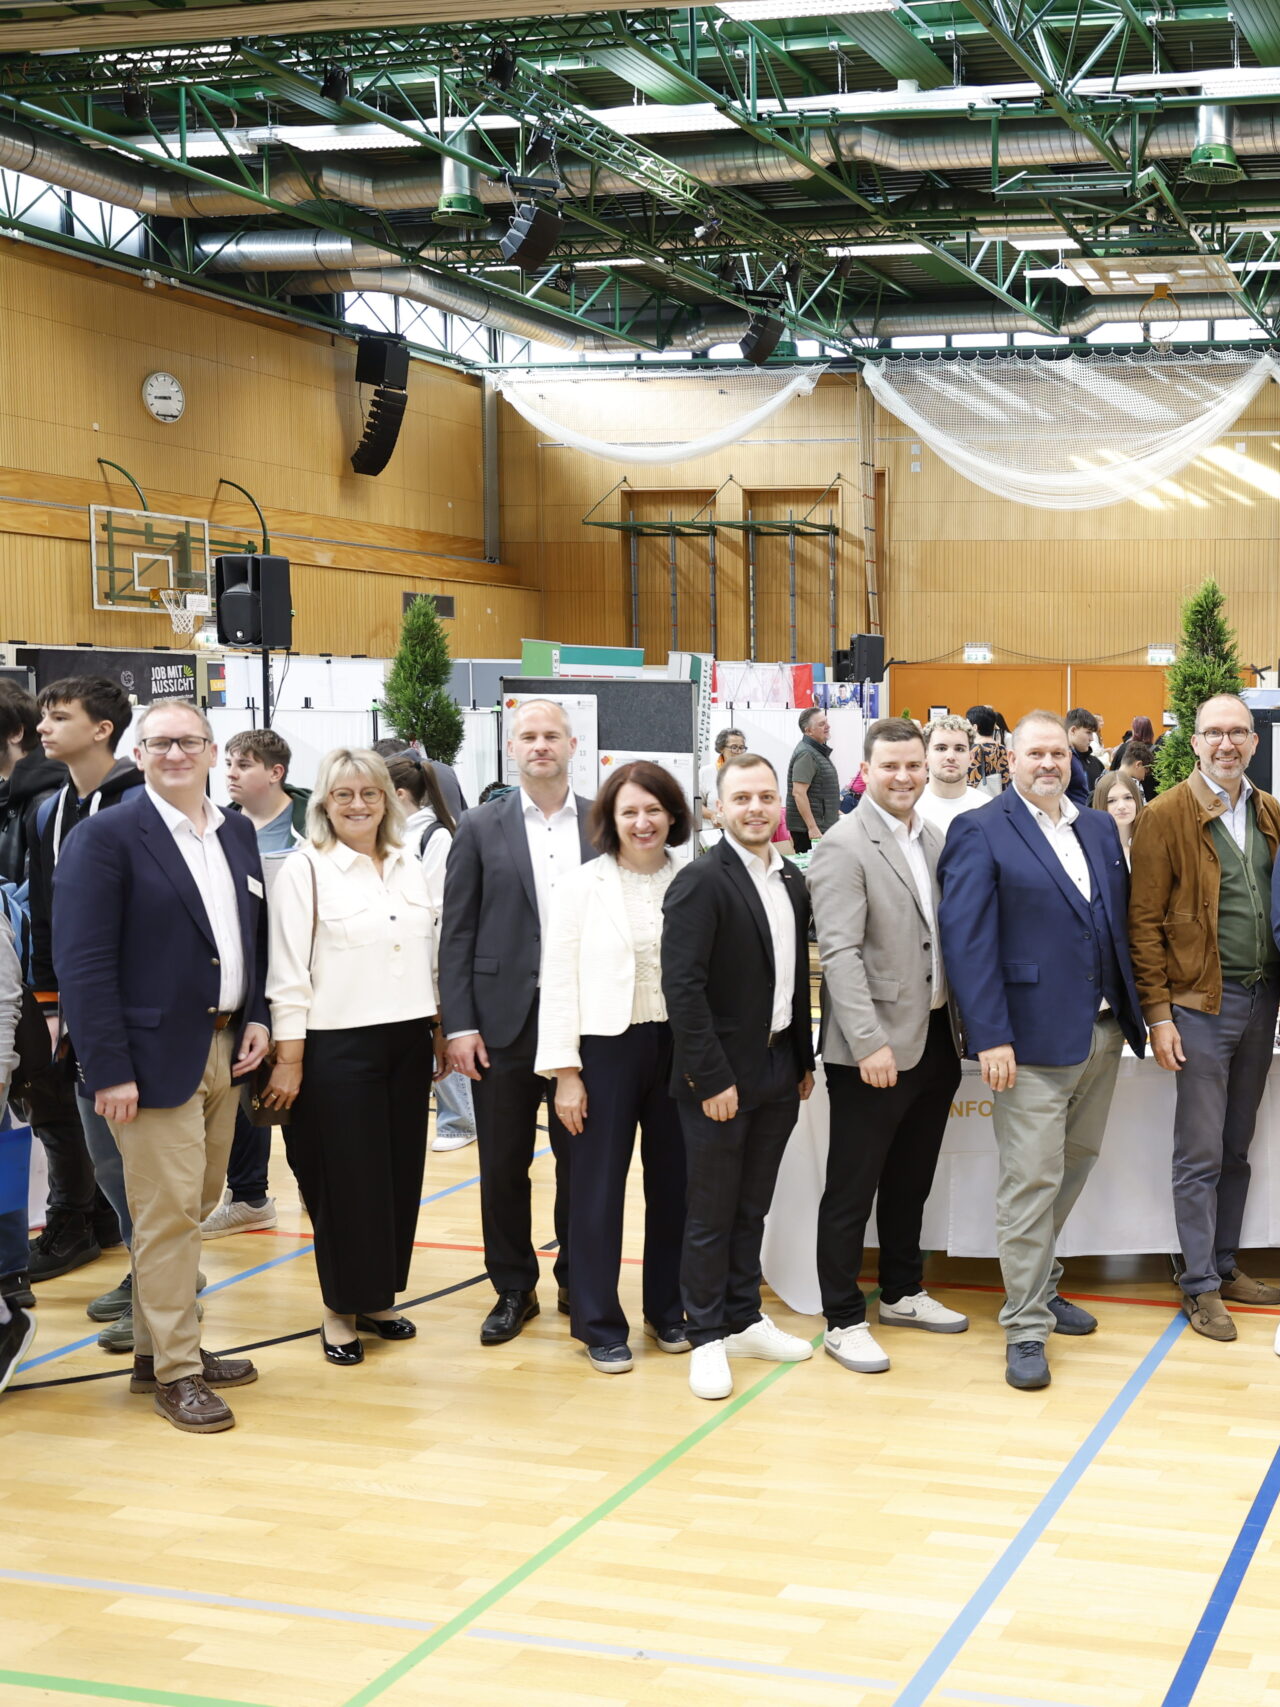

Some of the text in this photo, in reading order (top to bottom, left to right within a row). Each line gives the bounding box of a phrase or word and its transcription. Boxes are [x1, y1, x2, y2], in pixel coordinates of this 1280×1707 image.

[151, 665, 183, 680] JOB MIT
[151, 677, 195, 694] AUSSICHT
